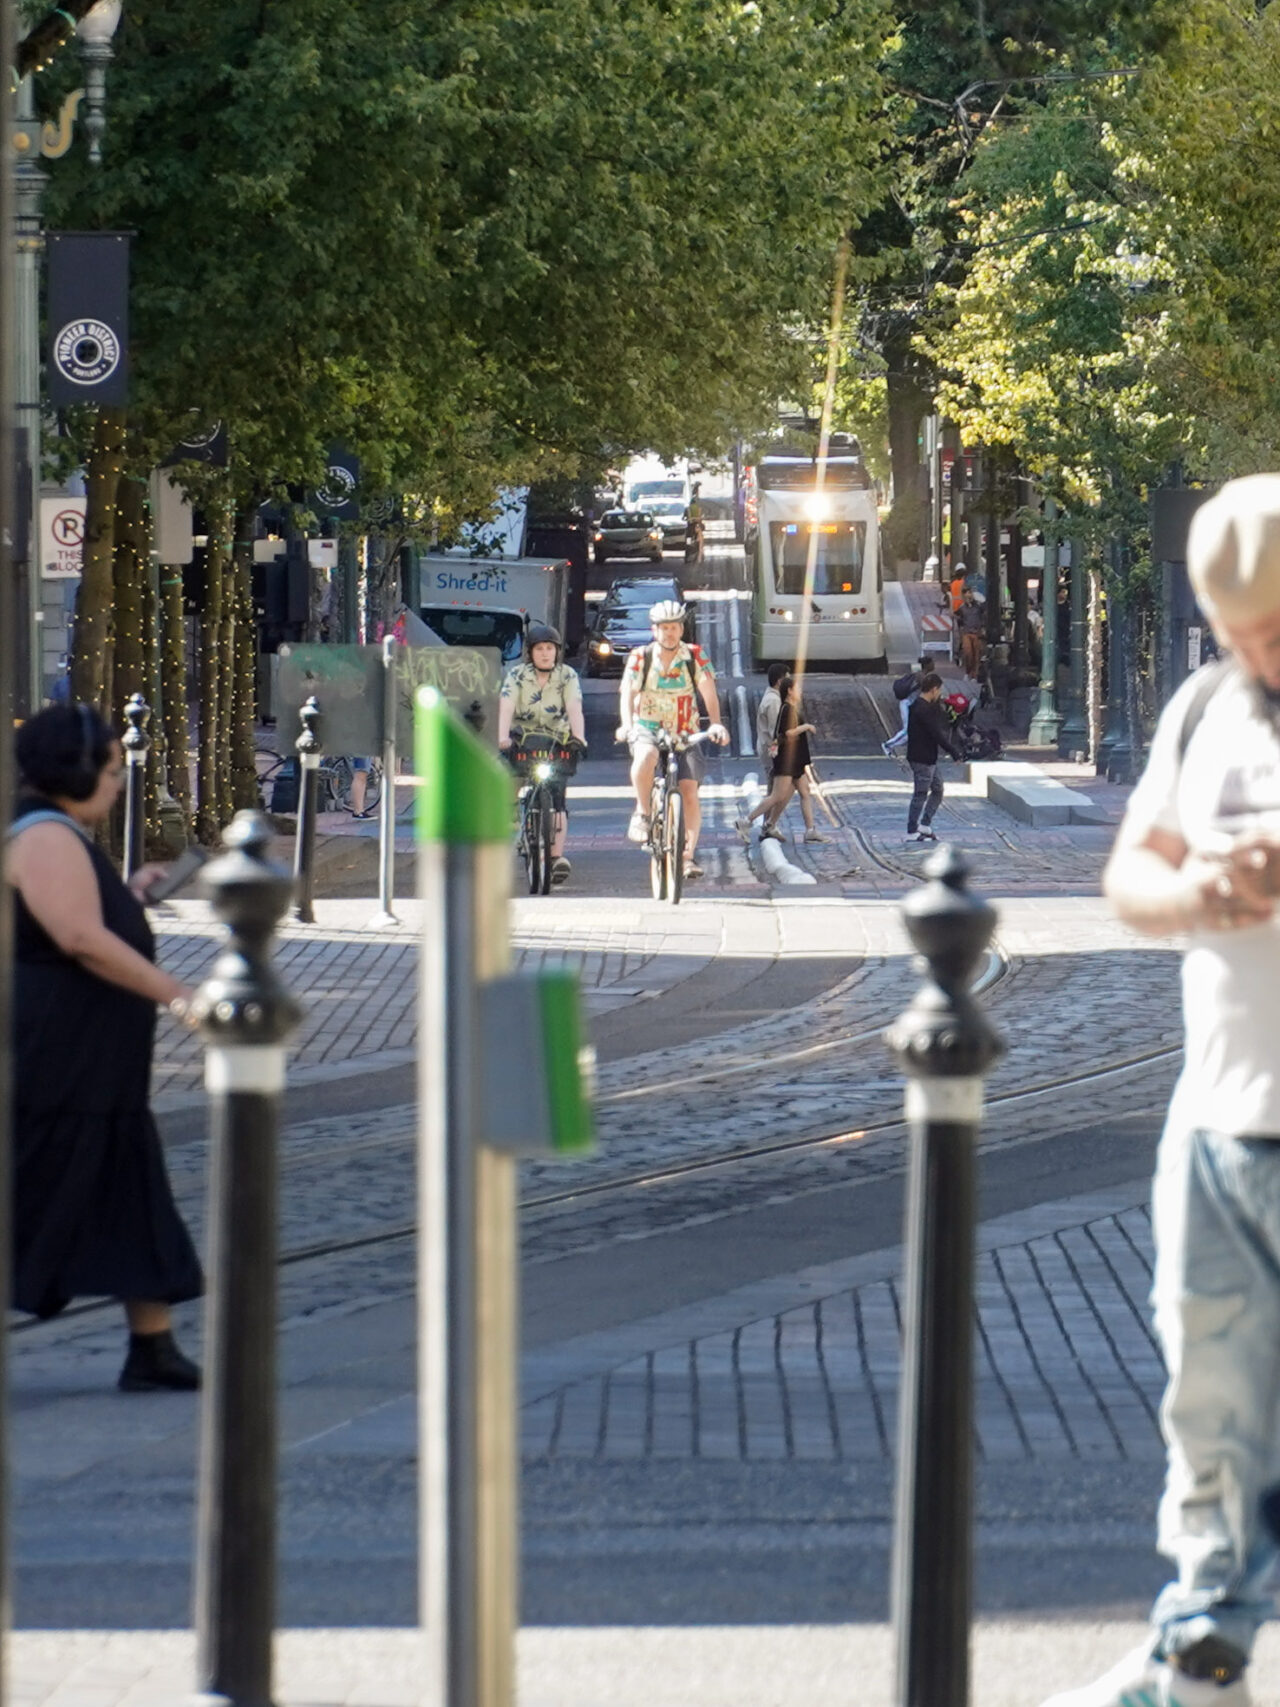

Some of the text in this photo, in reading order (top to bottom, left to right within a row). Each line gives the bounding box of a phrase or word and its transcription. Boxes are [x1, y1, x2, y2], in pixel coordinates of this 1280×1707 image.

[59, 324, 115, 362] PIONEER DISTRICT
[57, 550, 83, 560] THIS
[436, 572, 508, 593] Shred-it
